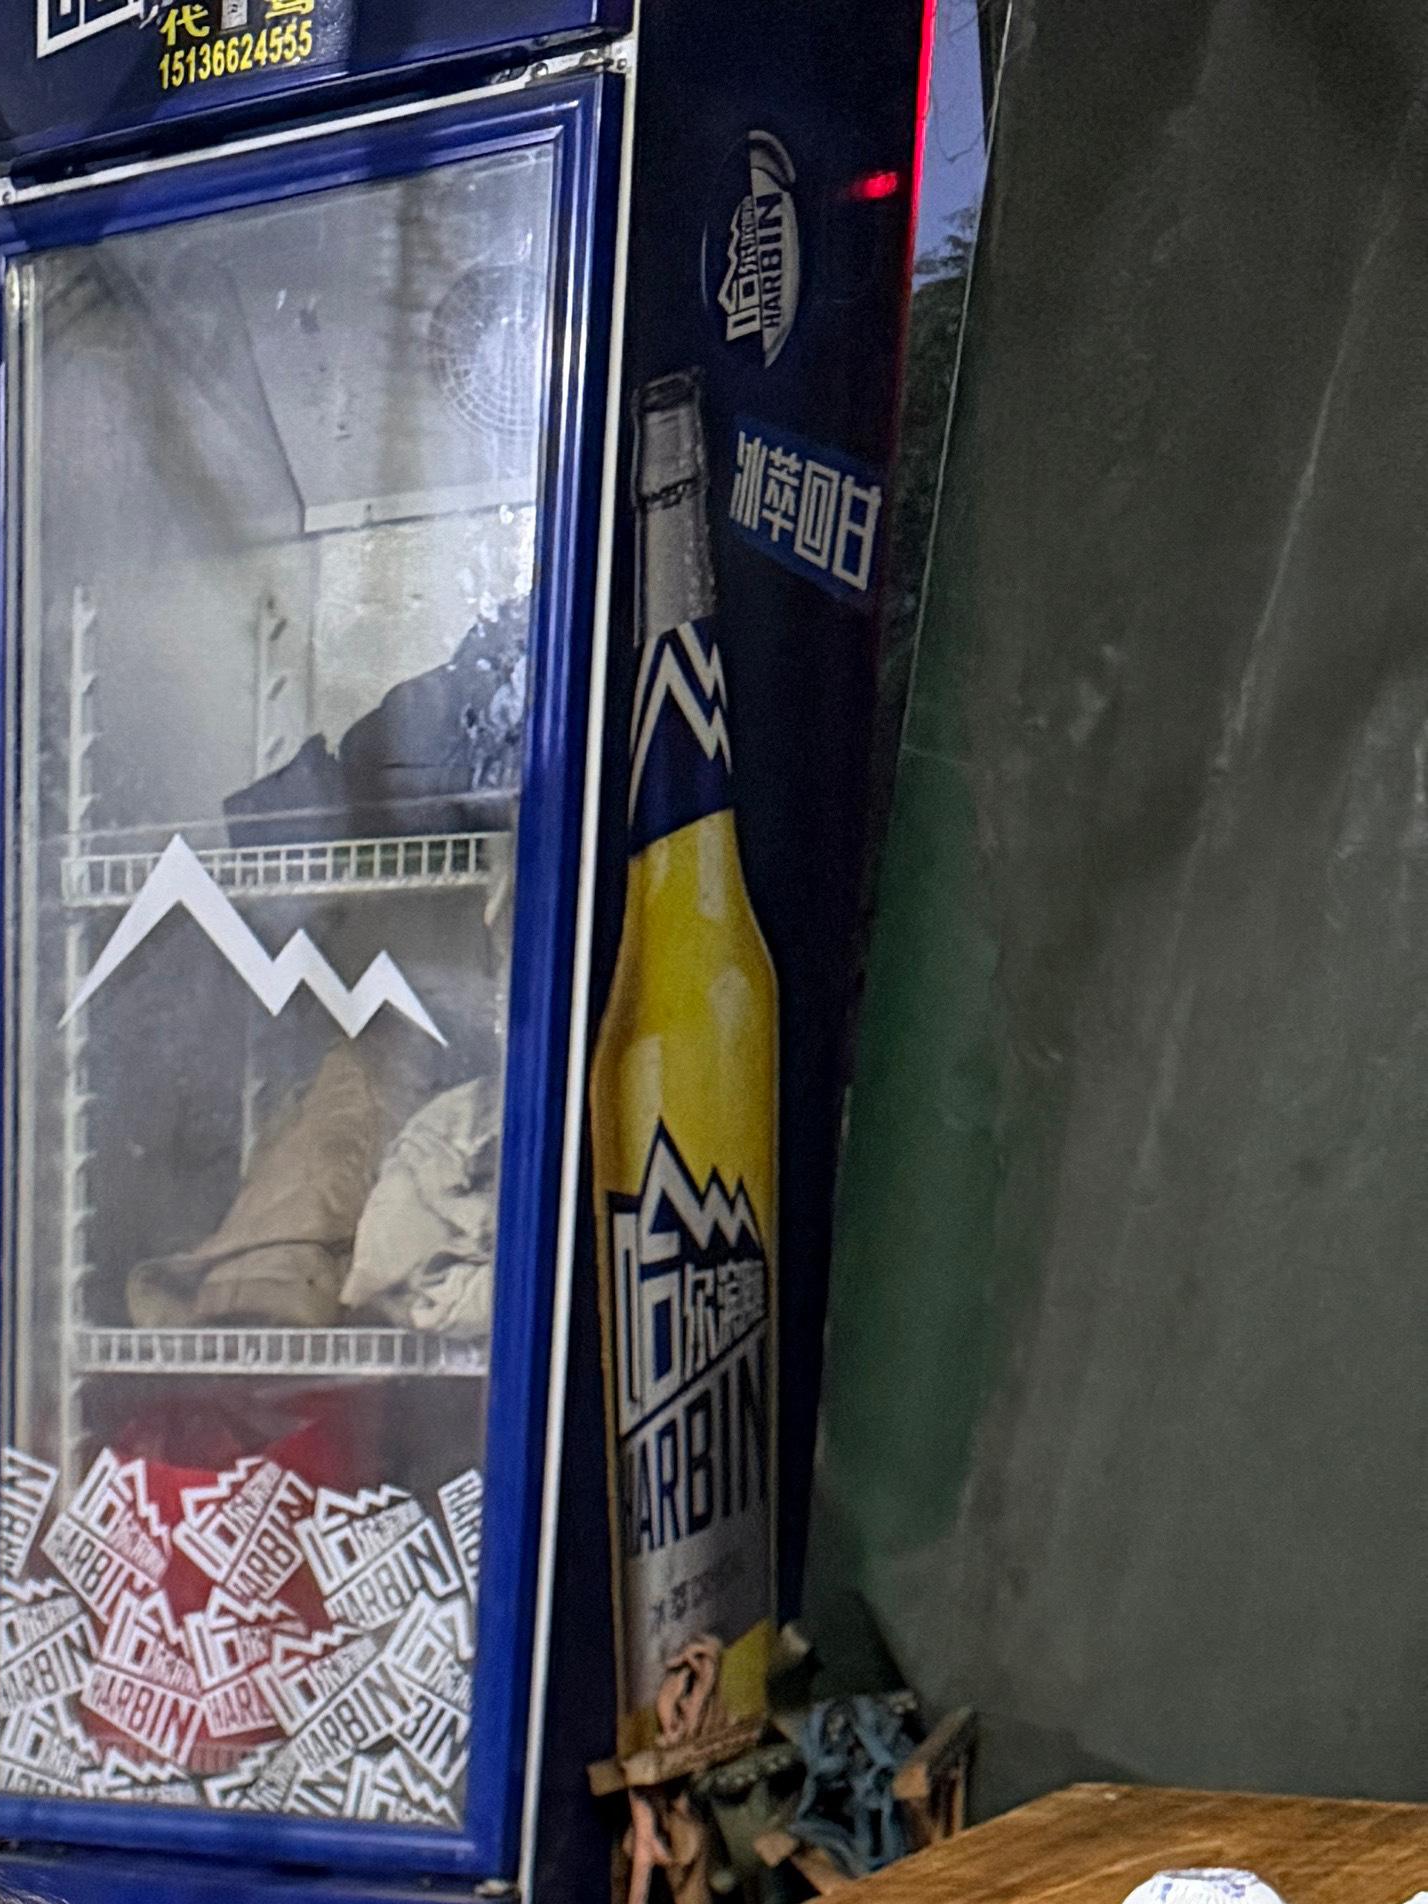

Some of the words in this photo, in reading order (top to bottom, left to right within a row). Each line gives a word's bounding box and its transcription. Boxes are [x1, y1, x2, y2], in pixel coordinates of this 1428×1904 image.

[159, 20, 313, 90] 15136624555
[755, 191, 784, 329] HARBIN
[620, 1335, 770, 1560] HARBIN
[329, 1520, 454, 1630] HARBIN
[95, 1671, 197, 1755] HARBIN
[297, 1660, 412, 1772] HARBIN
